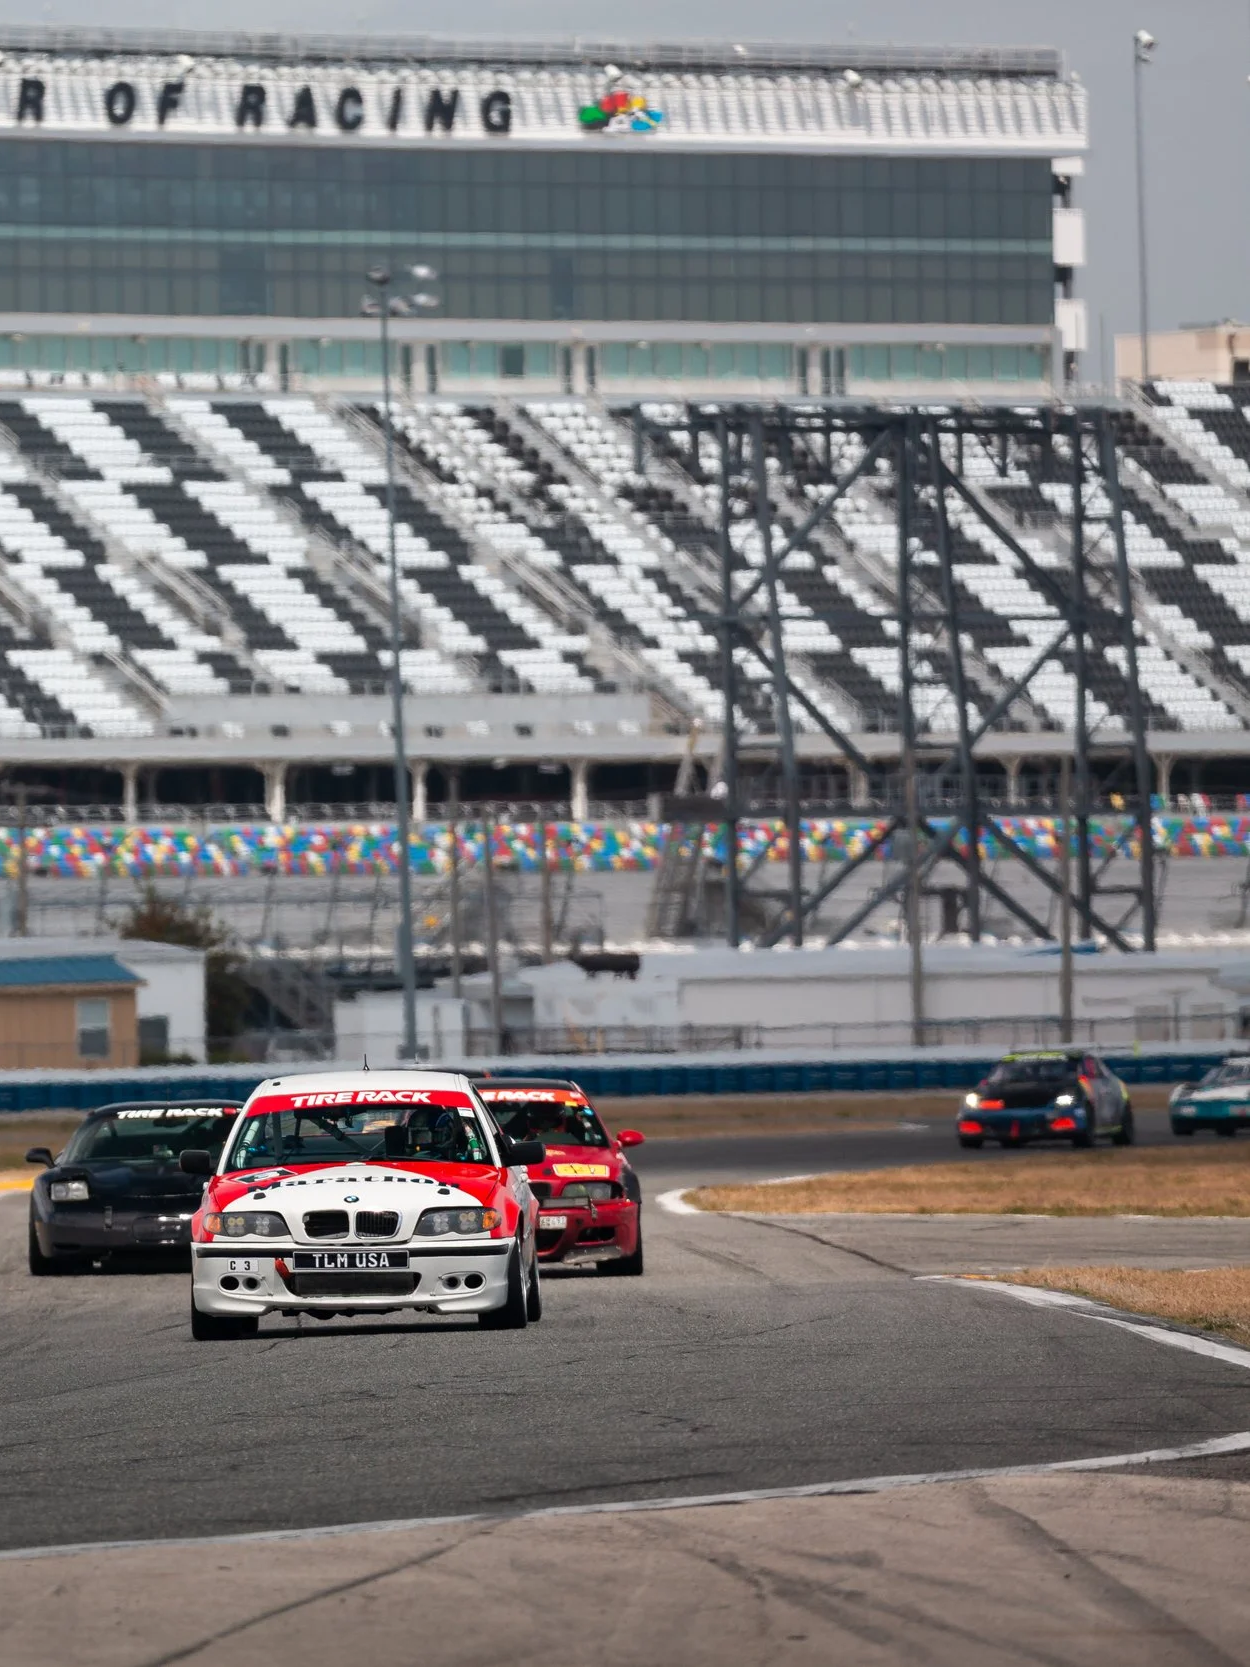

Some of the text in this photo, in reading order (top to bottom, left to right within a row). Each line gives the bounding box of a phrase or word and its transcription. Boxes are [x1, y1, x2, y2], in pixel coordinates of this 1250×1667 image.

[104, 81, 185, 125] OF
[236, 84, 512, 133] RACING
[291, 1090, 432, 1107] TIRE RACK
[498, 1091, 555, 1101] RACK
[117, 1107, 222, 1119] TIRE RACK
[230, 1260, 251, 1271] C 3
[313, 1252, 390, 1268] TLM USA
